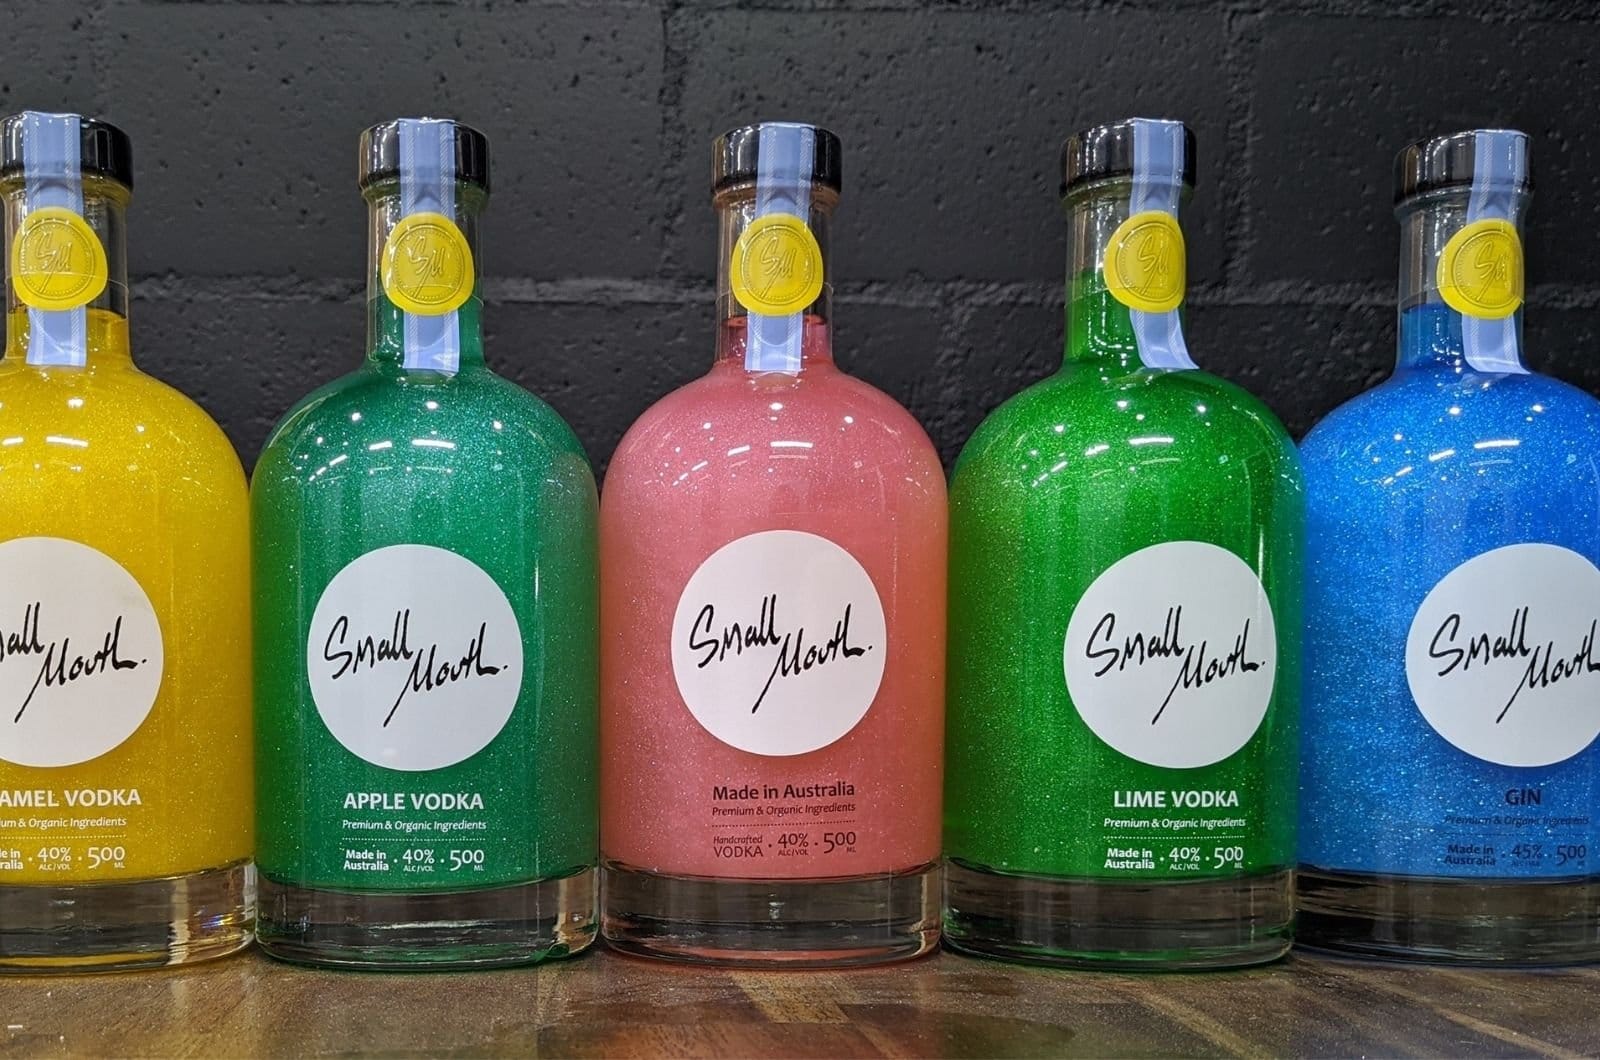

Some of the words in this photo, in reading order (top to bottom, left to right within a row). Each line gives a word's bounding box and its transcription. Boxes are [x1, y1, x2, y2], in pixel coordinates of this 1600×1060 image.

[0, 602, 45, 662] all
[689, 593, 781, 669] Small
[324, 609, 414, 680] Small
[1086, 605, 1185, 677] Small
[1429, 606, 1531, 677] Small
[0, 790, 59, 807] AMEL
[64, 789, 142, 807] VODKA
[713, 785, 759, 800] Made
[763, 784, 778, 799] in
[783, 781, 855, 799] Australia
[1505, 789, 1541, 805] GIN
[343, 793, 406, 809] APPLE
[410, 793, 484, 810] VODKA
[1114, 791, 1166, 808] LIME
[1171, 790, 1239, 808] VODKA
[712, 806, 755, 816] Premium
[756, 806, 764, 815] &
[766, 805, 803, 817] Organic
[805, 802, 856, 816] Ingredients
[18, 818, 27, 827] &
[28, 817, 68, 830] Organic
[70, 817, 127, 829] Ingredients
[342, 820, 383, 830] Premium
[384, 820, 393, 830] &
[394, 820, 432, 833] Organic
[433, 820, 487, 833] Ingredients
[1104, 818, 1151, 828] Premium
[1151, 818, 1160, 828] &
[1161, 818, 1198, 830] Organic
[1200, 818, 1246, 830] Ingredients
[1444, 816, 1492, 826] Premium
[1504, 816, 1540, 828] Organic
[713, 835, 763, 844] Handcrafted
[778, 833, 809, 848] 40%
[824, 831, 856, 854] 500
[11, 848, 21, 859] in
[346, 849, 374, 860] Made
[376, 849, 386, 860] in
[713, 846, 763, 858] VODKA
[1107, 848, 1139, 858] Made
[1142, 848, 1152, 858] in
[1448, 844, 1480, 854] Made
[1483, 844, 1493, 854] in
[1511, 844, 1542, 859] 45%
[1556, 844, 1587, 867] 500
[0, 860, 24, 870] ralia
[37, 847, 72, 862] 40%
[87, 846, 125, 869] 500
[402, 849, 435, 864] 40%
[450, 849, 485, 872] 500
[1104, 859, 1155, 869] Australia
[1169, 847, 1200, 862] 40%
[1214, 846, 1244, 869] 500
[1444, 855, 1496, 866] Australia
[343, 860, 389, 871] Australia
